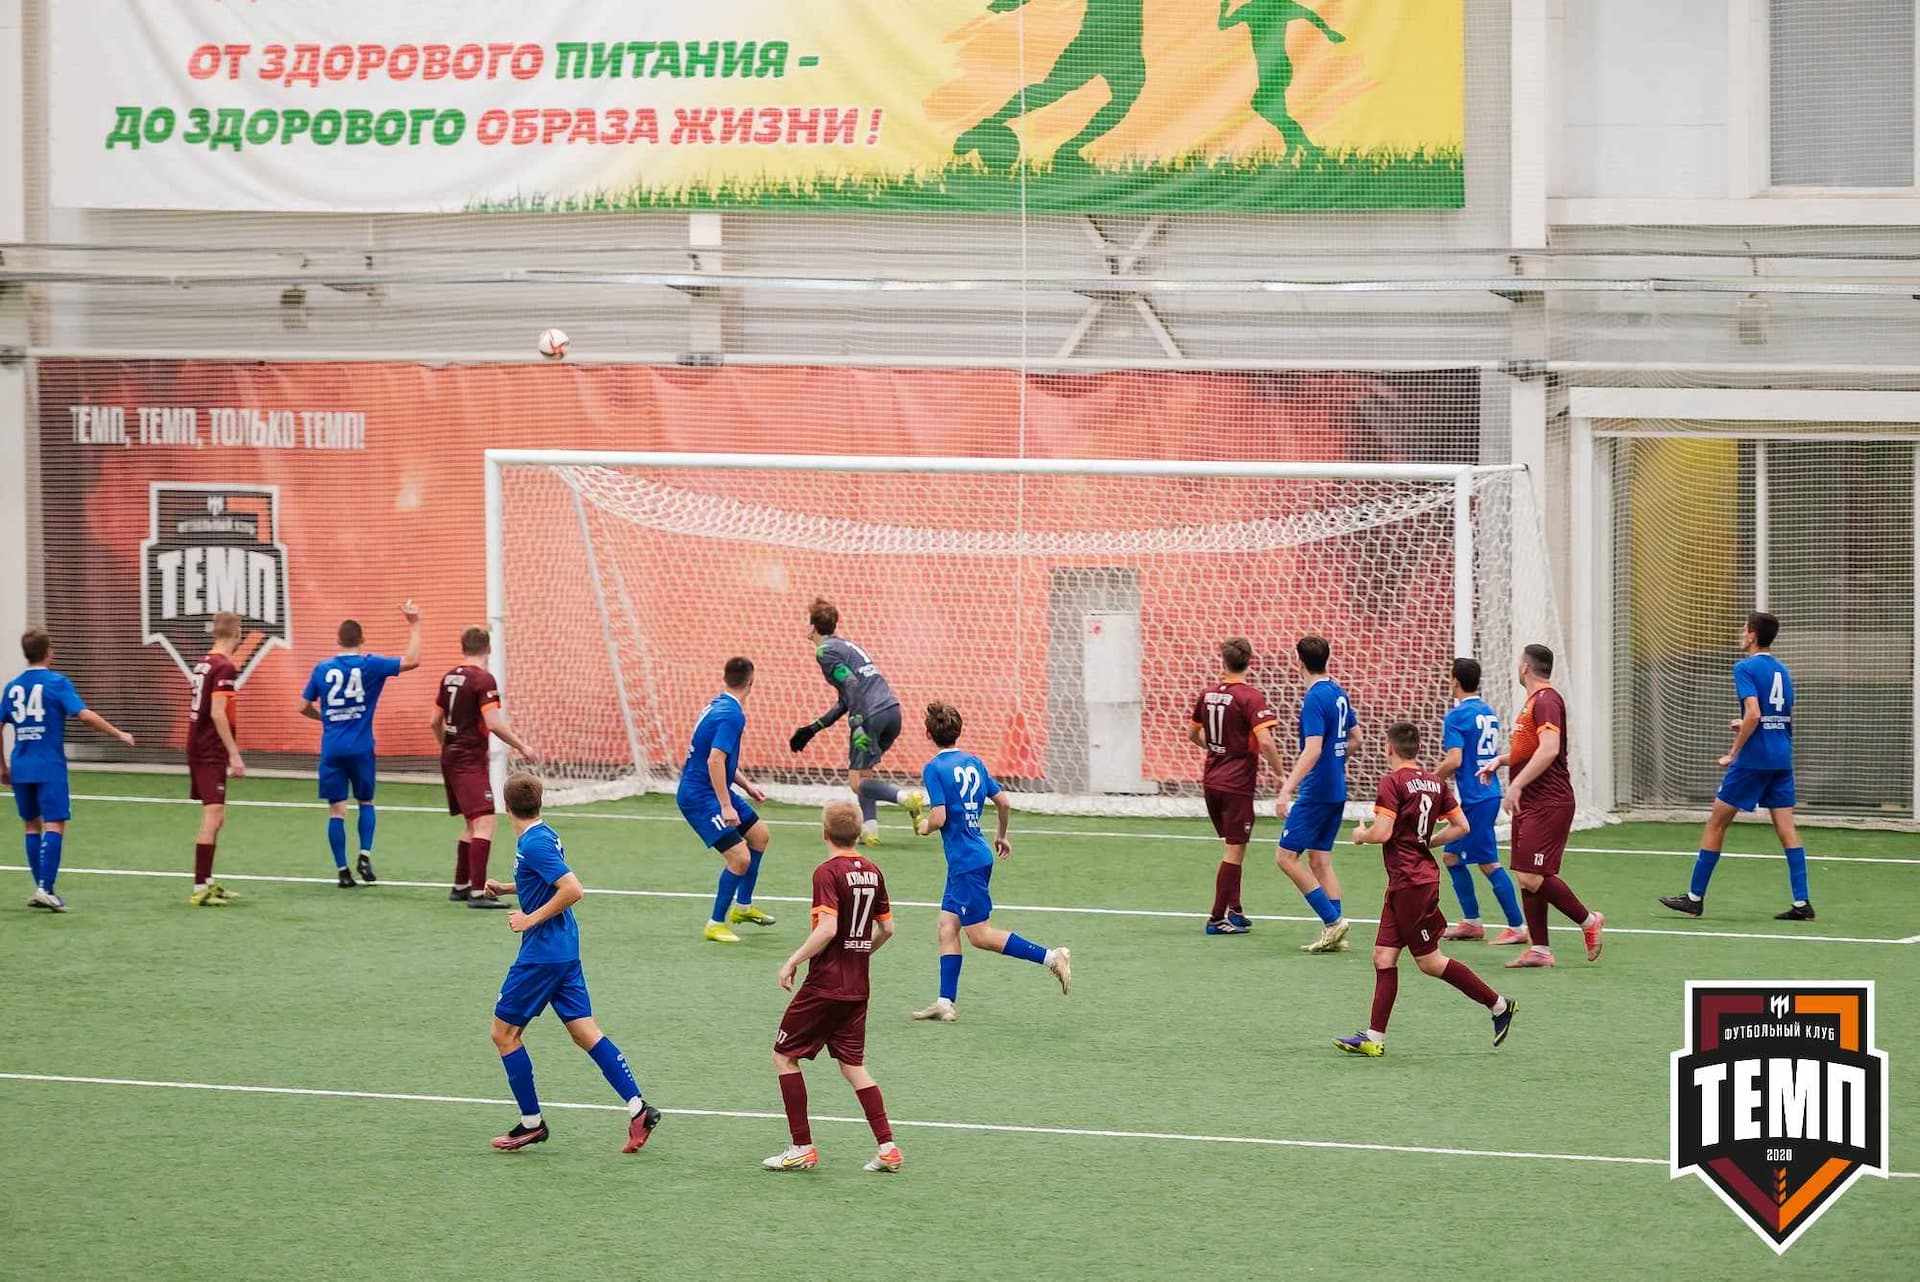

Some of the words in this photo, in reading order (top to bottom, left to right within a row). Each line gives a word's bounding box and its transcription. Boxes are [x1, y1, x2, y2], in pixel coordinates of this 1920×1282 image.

[188, 44, 251, 80] ОТ
[258, 43, 544, 88] ЗДОРОВОГО
[555, 41, 789, 79] ПИТАНИЯ
[105, 107, 176, 149] ДО
[183, 108, 466, 152] ЗДОРОВОГО
[476, 108, 660, 145] ОБРАЗА
[669, 108, 859, 145] ЖИЗНИ
[70, 406, 131, 449] ТЕМП,
[137, 407, 203, 449] ТЕМП,
[208, 409, 295, 448] ТОЛЬКО
[301, 411, 366, 449] ТЕМП!
[157, 546, 277, 625] ТЕМП
[8, 683, 46, 723] 34
[325, 667, 366, 706] 24
[447, 686, 458, 724] 7
[1769, 671, 1785, 712] 4
[1206, 704, 1225, 745] 11
[1475, 714, 1500, 756] 25
[1417, 793, 1433, 837] 8
[1534, 853, 1545, 866] 13
[849, 887, 875, 938] 17
[1420, 929, 1431, 943] 8
